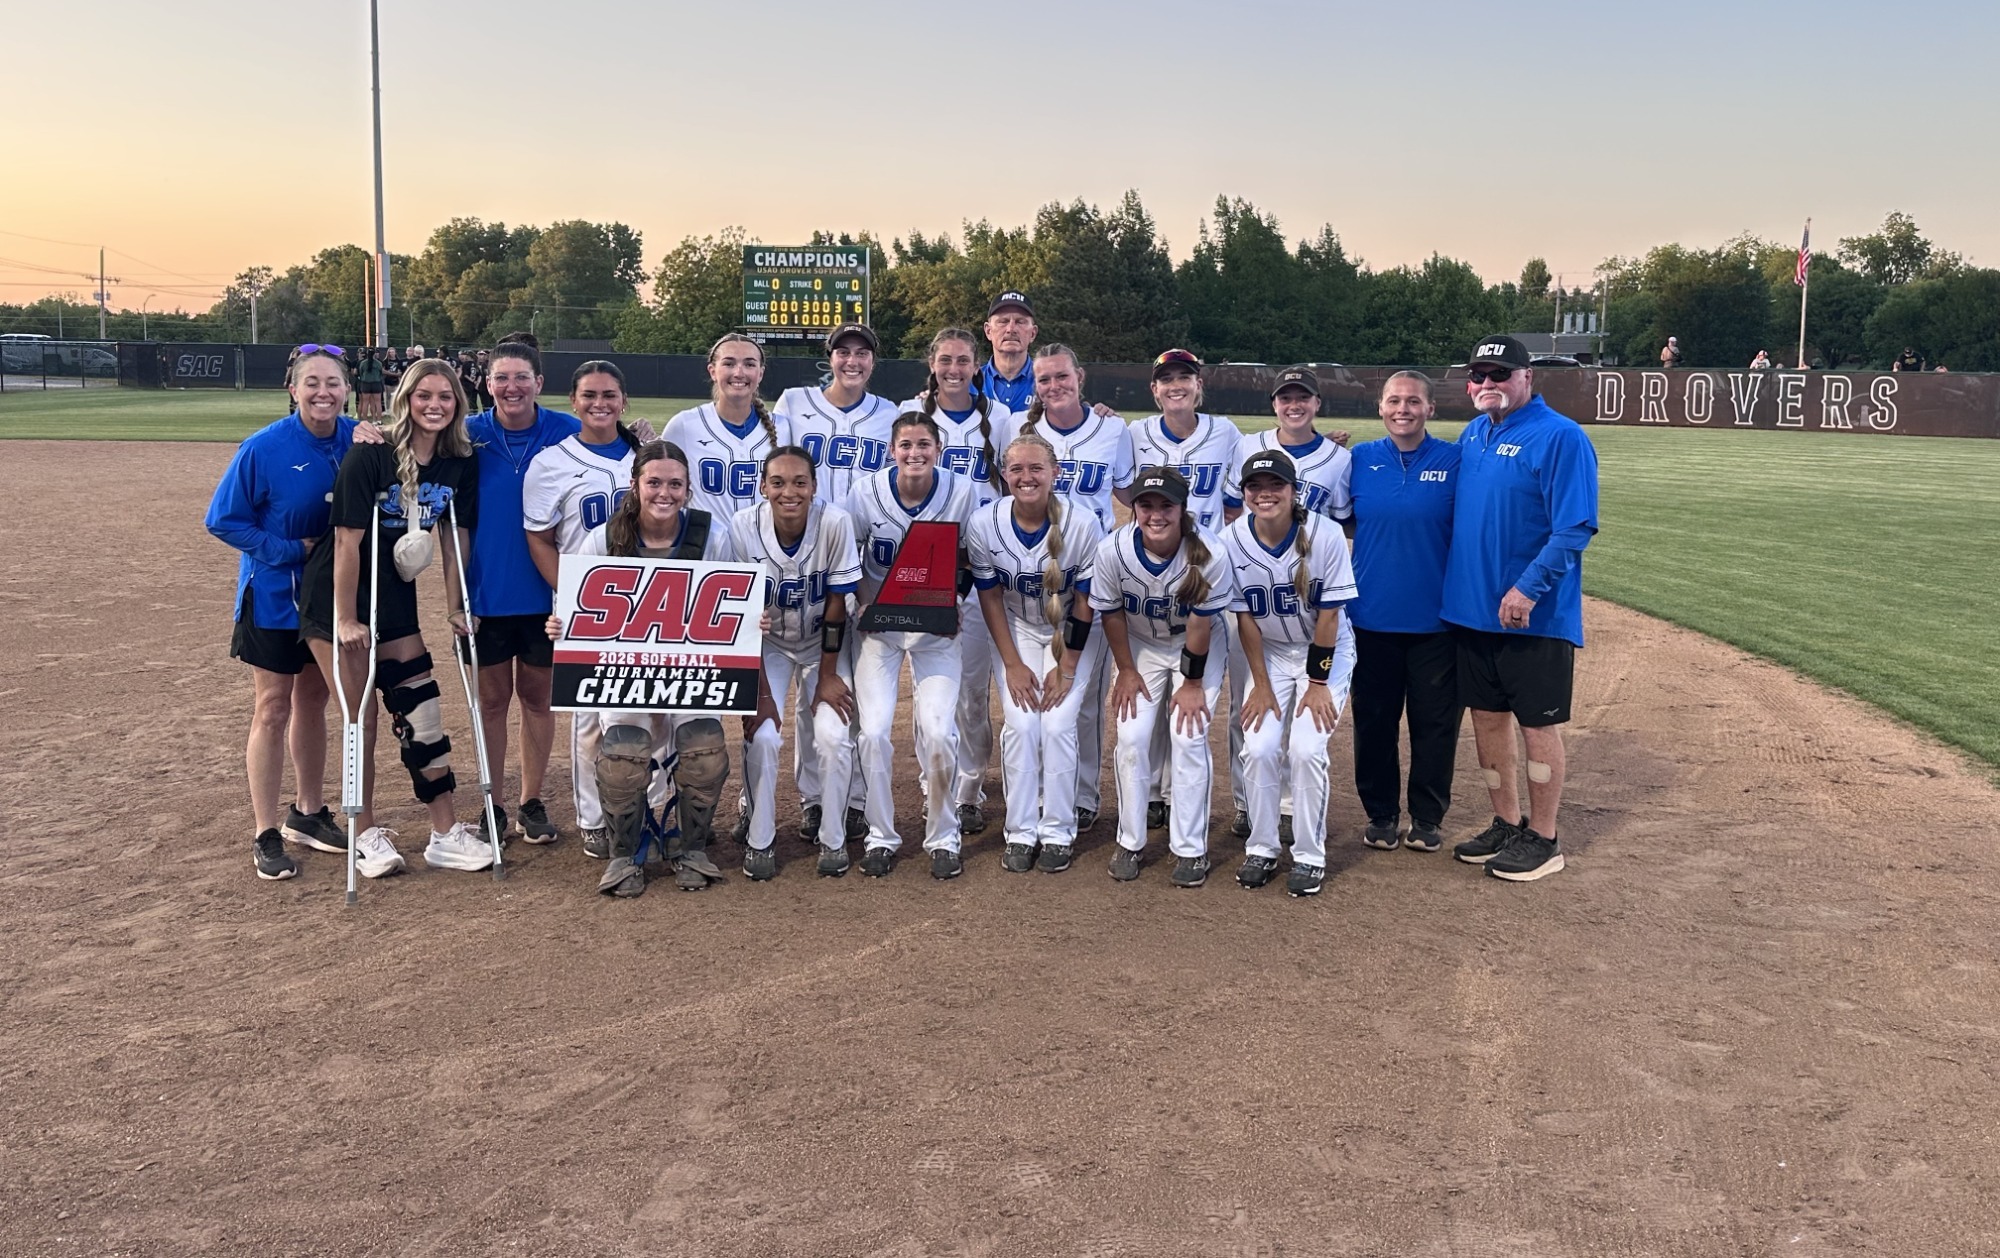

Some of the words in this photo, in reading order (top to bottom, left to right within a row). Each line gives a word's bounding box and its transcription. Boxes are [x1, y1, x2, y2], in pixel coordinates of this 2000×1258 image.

[754, 252, 858, 267] CHAMPIONS
[772, 278, 779, 290] 0
[814, 279, 822, 290] 0
[852, 280, 859, 291] 0
[746, 302, 768, 310] GUEST
[770, 301, 778, 312] 0
[780, 301, 788, 312] 0
[790, 301, 798, 312] 0
[803, 301, 809, 312] 3
[812, 301, 820, 312] 0
[822, 301, 830, 312] 0
[835, 302, 841, 313] 3
[854, 302, 862, 313] 6
[747, 314, 768, 323] HOME
[770, 313, 778, 325] 0
[780, 313, 788, 325] 0
[794, 314, 798, 324] 1
[802, 314, 809, 325] 0
[812, 314, 820, 325] 0
[822, 314, 830, 325] 0
[834, 314, 841, 325] 0
[1476, 343, 1506, 357] OCU
[176, 355, 224, 377] SAC
[1596, 371, 1899, 431] DROVERS
[800, 433, 888, 472] OCU
[1496, 443, 1522, 457] OCU
[1253, 460, 1274, 469] OCU
[698, 458, 767, 499] OC
[1144, 478, 1164, 487] OCU
[1420, 470, 1448, 482] OCU
[896, 567, 928, 582] SAC
[565, 564, 757, 645] SAC
[874, 614, 922, 625] SOFTBALL
[598, 652, 635, 664] 2026
[641, 653, 716, 667] SOFTBALL
[594, 666, 721, 680] TOURNAMENT
[575, 678, 738, 707] CHAMPS!
